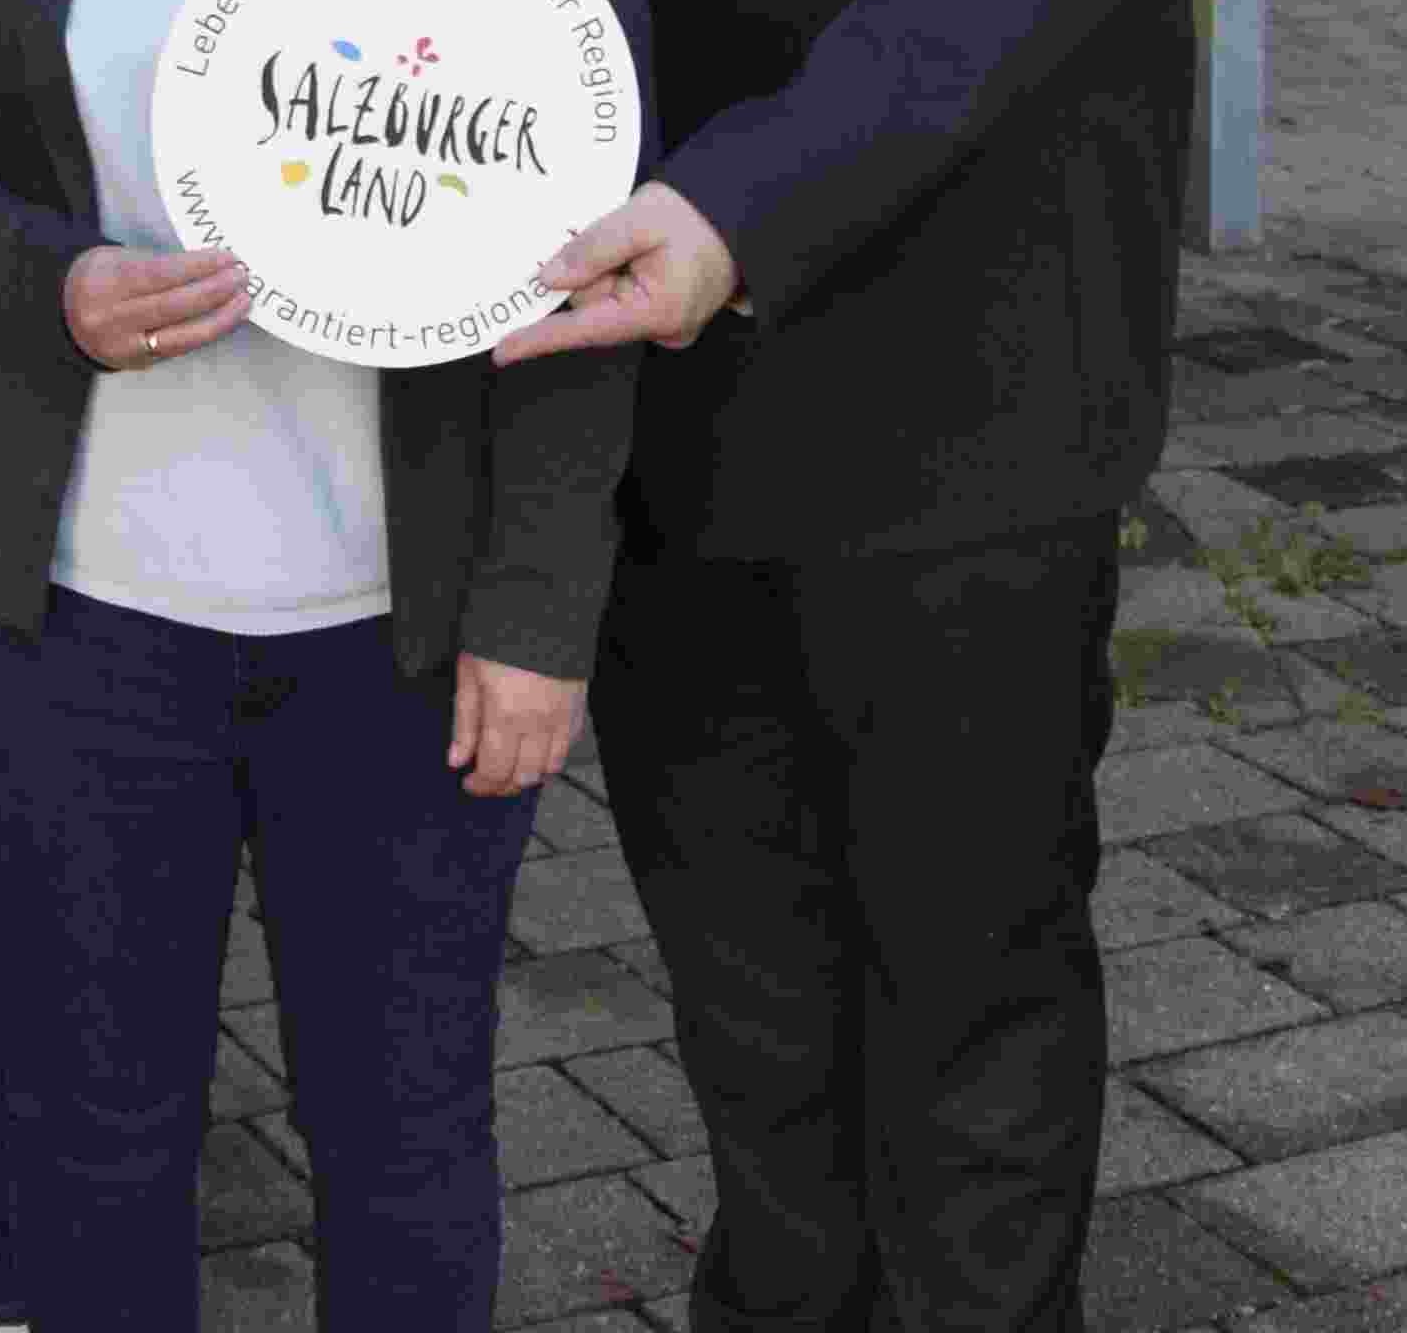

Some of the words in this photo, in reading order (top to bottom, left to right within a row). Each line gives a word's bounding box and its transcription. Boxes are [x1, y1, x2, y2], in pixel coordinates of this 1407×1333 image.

[257, 50, 547, 176] SALZBURGER
[570, 16, 622, 144] Region
[320, 141, 427, 228] LAND
